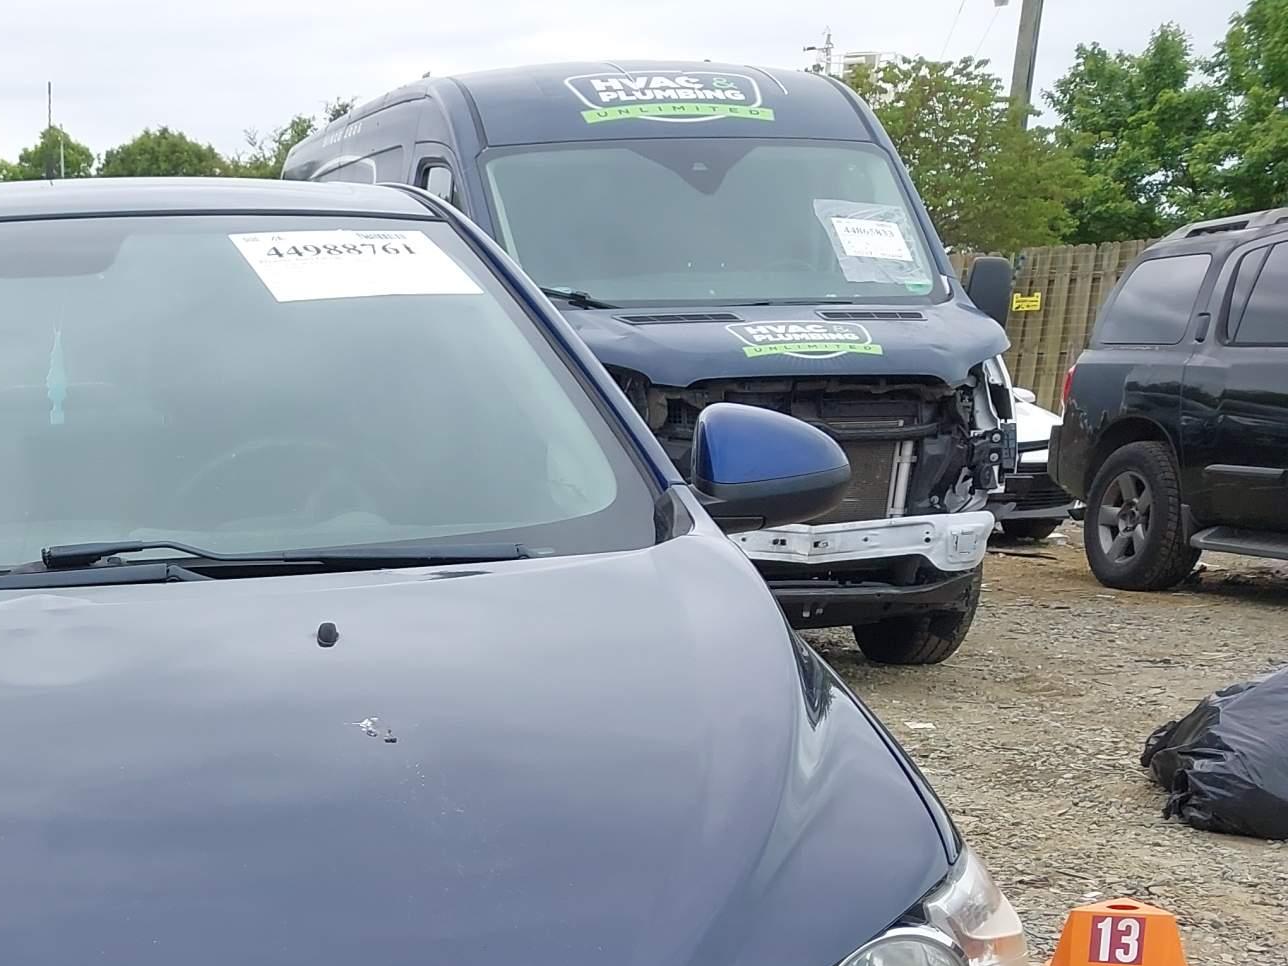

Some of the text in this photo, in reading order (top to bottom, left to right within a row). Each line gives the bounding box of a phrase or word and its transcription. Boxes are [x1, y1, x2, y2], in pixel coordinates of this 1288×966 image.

[590, 76, 739, 91] HVAC &
[598, 88, 746, 102] PLUMBING
[597, 105, 761, 118] UNLIMITED
[266, 242, 417, 259] 44988761
[743, 324, 828, 335] HVAC
[751, 332, 861, 342] PLUMBING
[753, 344, 872, 353] UNLIMITED
[1097, 916, 1140, 963] 13
